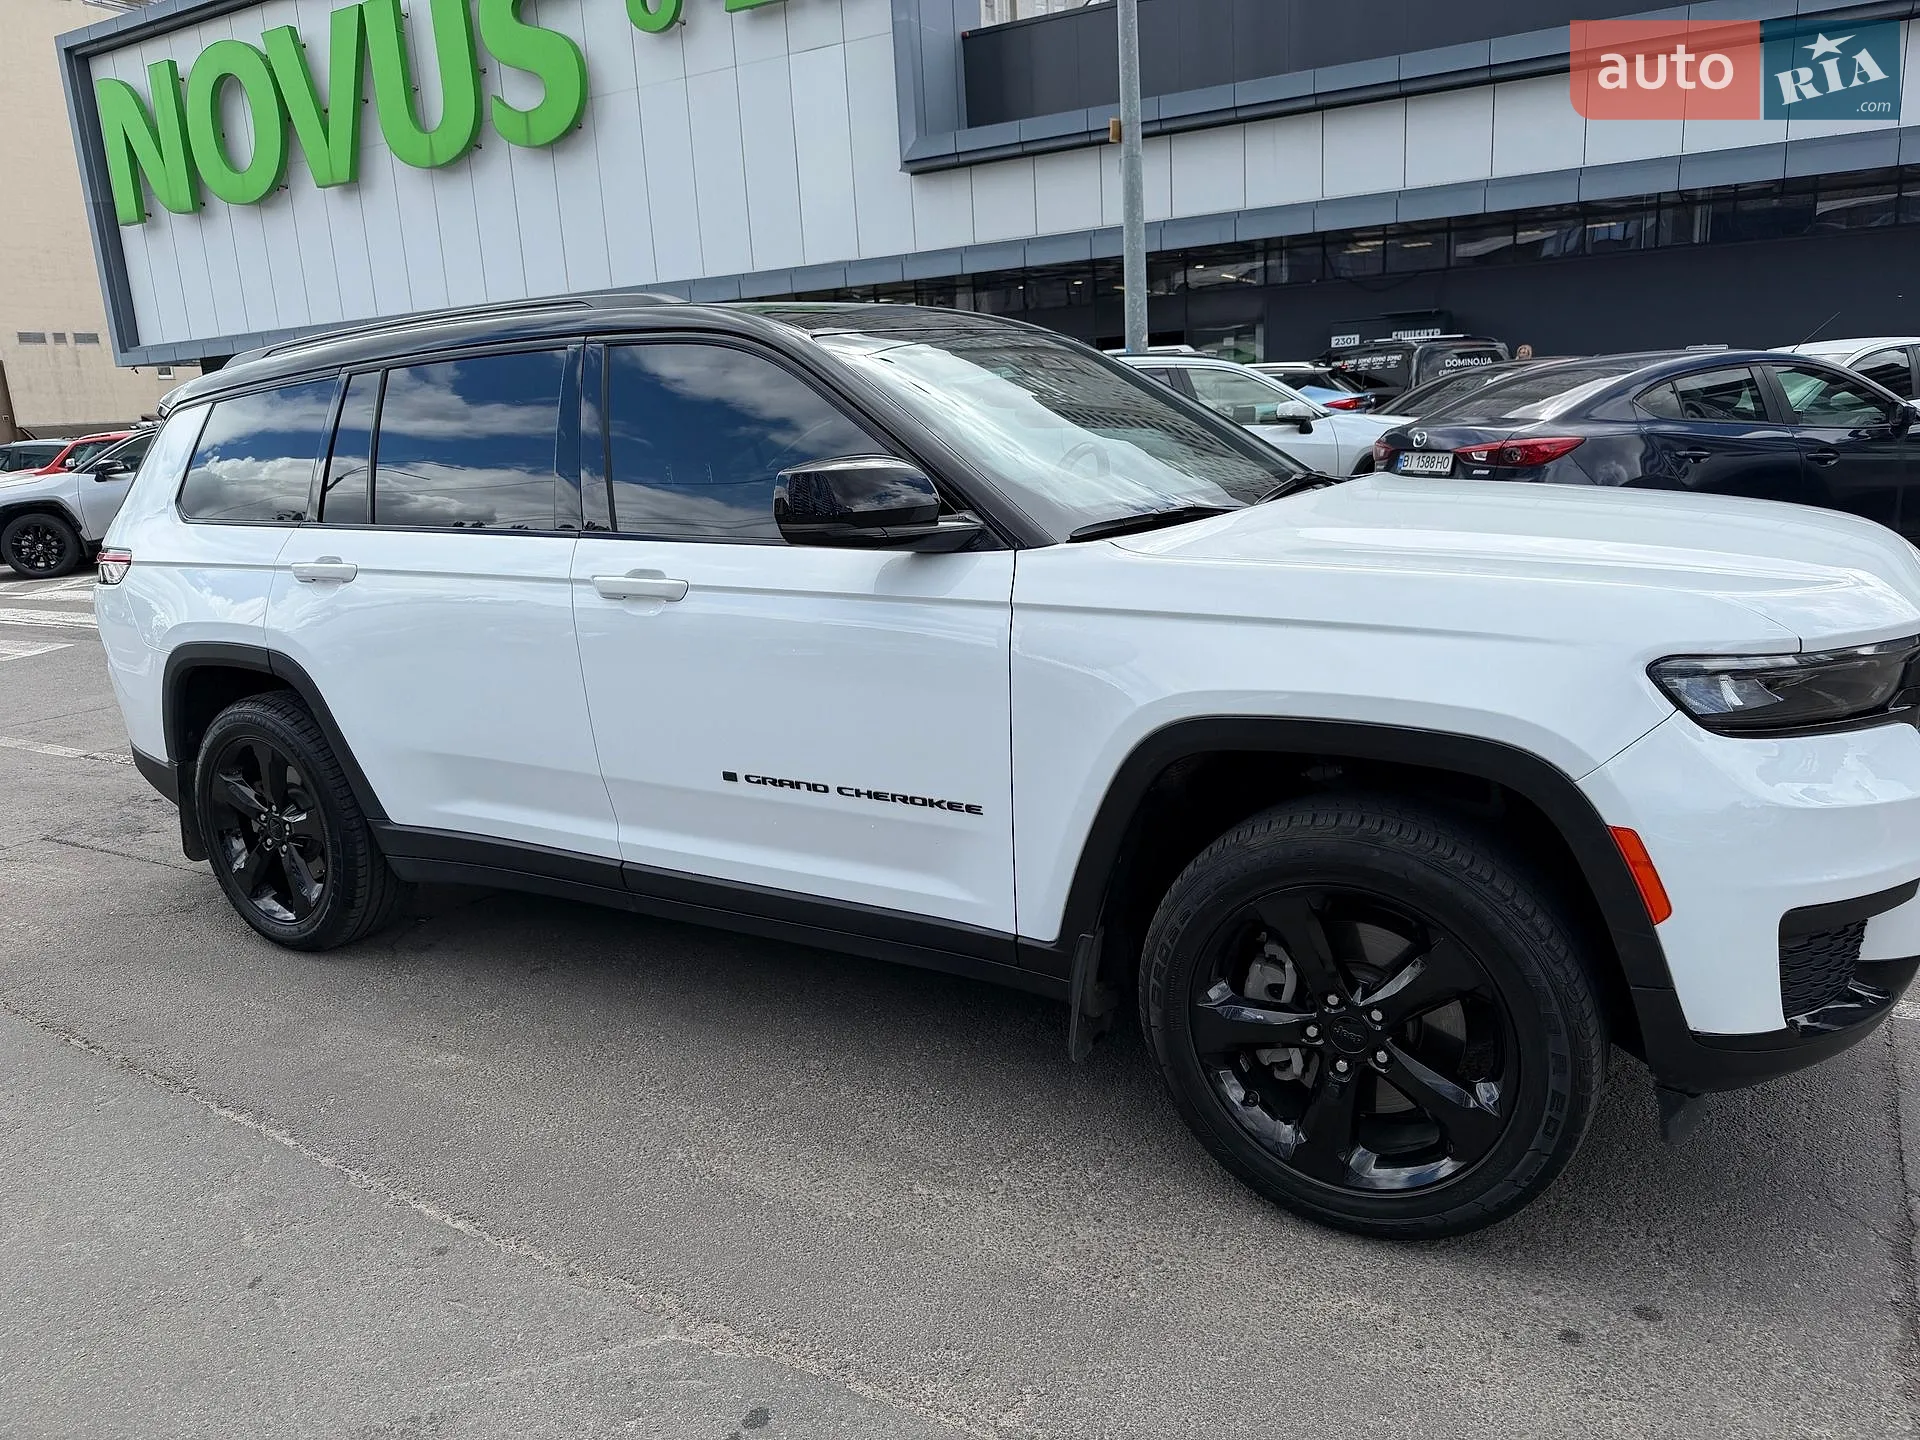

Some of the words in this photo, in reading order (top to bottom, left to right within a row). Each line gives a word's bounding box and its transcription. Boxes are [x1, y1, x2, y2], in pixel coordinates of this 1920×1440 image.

[97, 0, 588, 226] NOVUS
[1334, 337, 1356, 346] 2301
[1445, 357, 1493, 368] DOMINO.UA
[744, 773, 830, 794] GRAND
[836, 785, 984, 816] CHEROKEE
